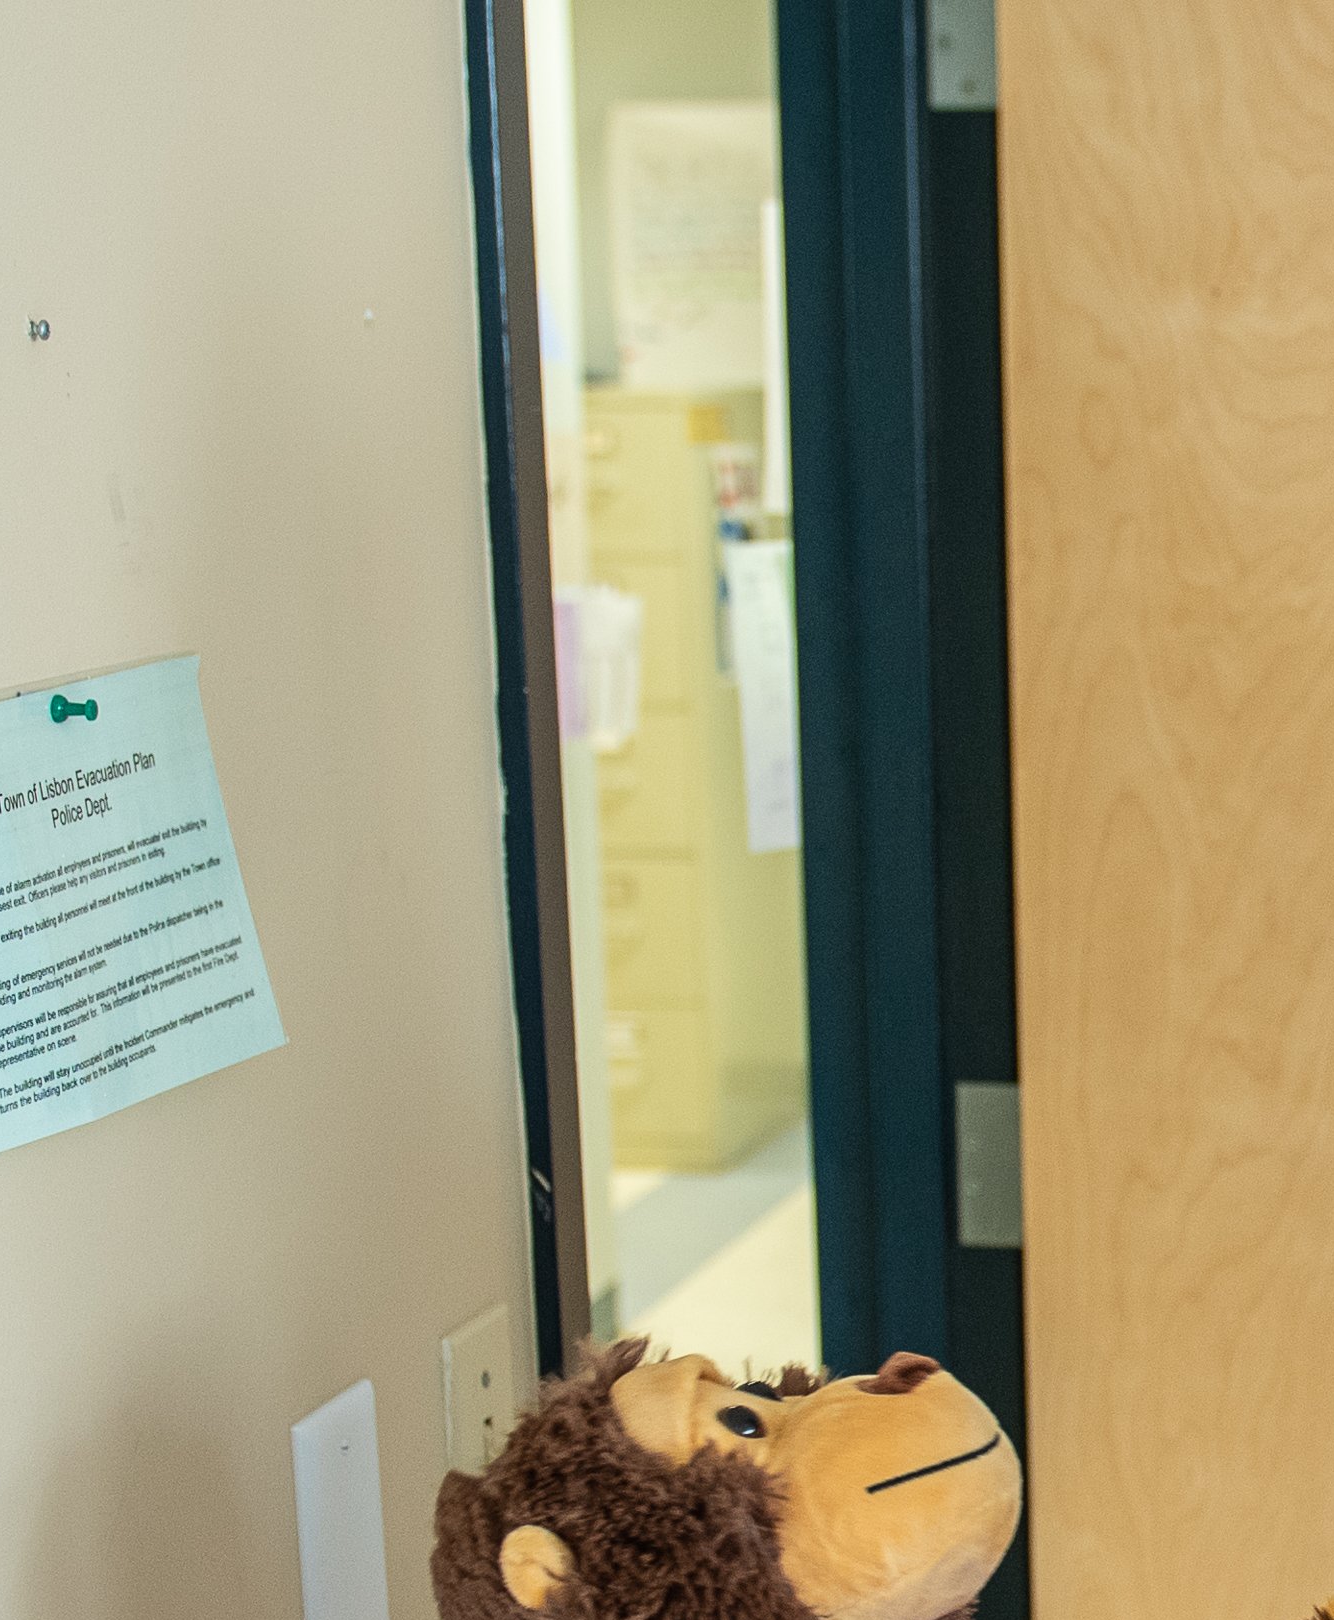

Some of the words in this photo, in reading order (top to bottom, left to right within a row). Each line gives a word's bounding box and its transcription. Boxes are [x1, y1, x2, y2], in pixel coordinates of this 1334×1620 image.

[27, 783, 38, 805] of
[38, 777, 74, 801] Lisbon
[75, 760, 131, 789] Evacuation
[132, 752, 155, 772] Plan
[51, 804, 83, 828] Police
[84, 793, 112, 817] Dept.
[5, 881, 12, 894] of
[13, 879, 31, 891] alarm
[13, 895, 27, 907] exit.
[28, 888, 49, 902] Officers
[0, 929, 23, 943] exiting
[23, 925, 34, 935] the
[12, 973, 20, 986] of
[17, 986, 30, 1000] and
[31, 976, 64, 994] monitoring
[34, 1012, 46, 1025] will
[46, 1010, 56, 1021] be
[46, 1041, 56, 1052] on
[57, 1034, 76, 1048] scene.
[13, 1077, 43, 1093] building
[43, 1070, 55, 1083] will
[56, 1067, 70, 1079] stay
[0, 1100, 18, 1114] turns
[19, 1096, 32, 1107] the
[33, 1085, 61, 1102] building
[61, 1078, 78, 1092] back
